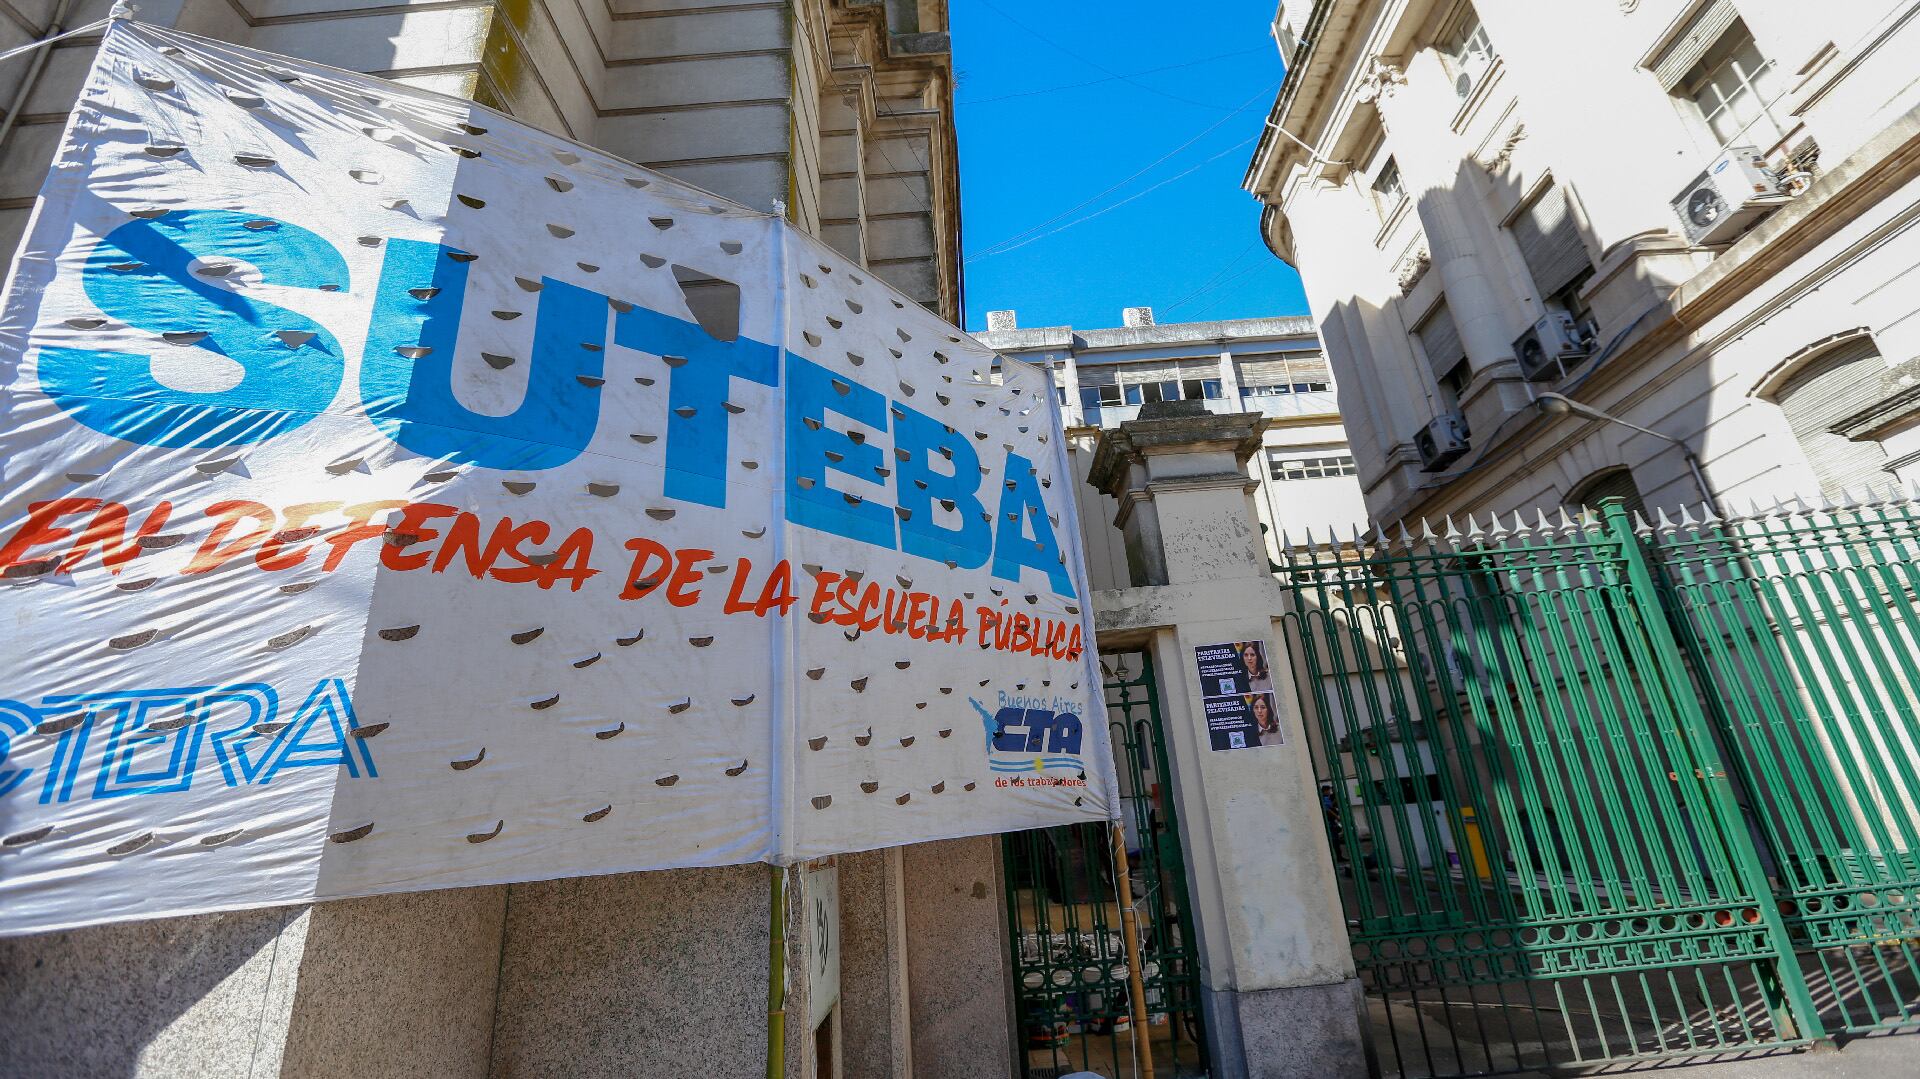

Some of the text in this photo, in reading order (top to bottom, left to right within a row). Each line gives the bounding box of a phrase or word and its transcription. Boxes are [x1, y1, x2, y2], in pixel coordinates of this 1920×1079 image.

[37, 208, 1078, 600] SUTEBA
[0, 498, 1084, 662] EN DEFENSA DE LA ESCUELA PÚBLICA
[998, 690, 1083, 715] Buenos Aires
[992, 707, 1083, 755] CTA
[994, 777, 1007, 788] de
[1010, 777, 1025, 787] los
